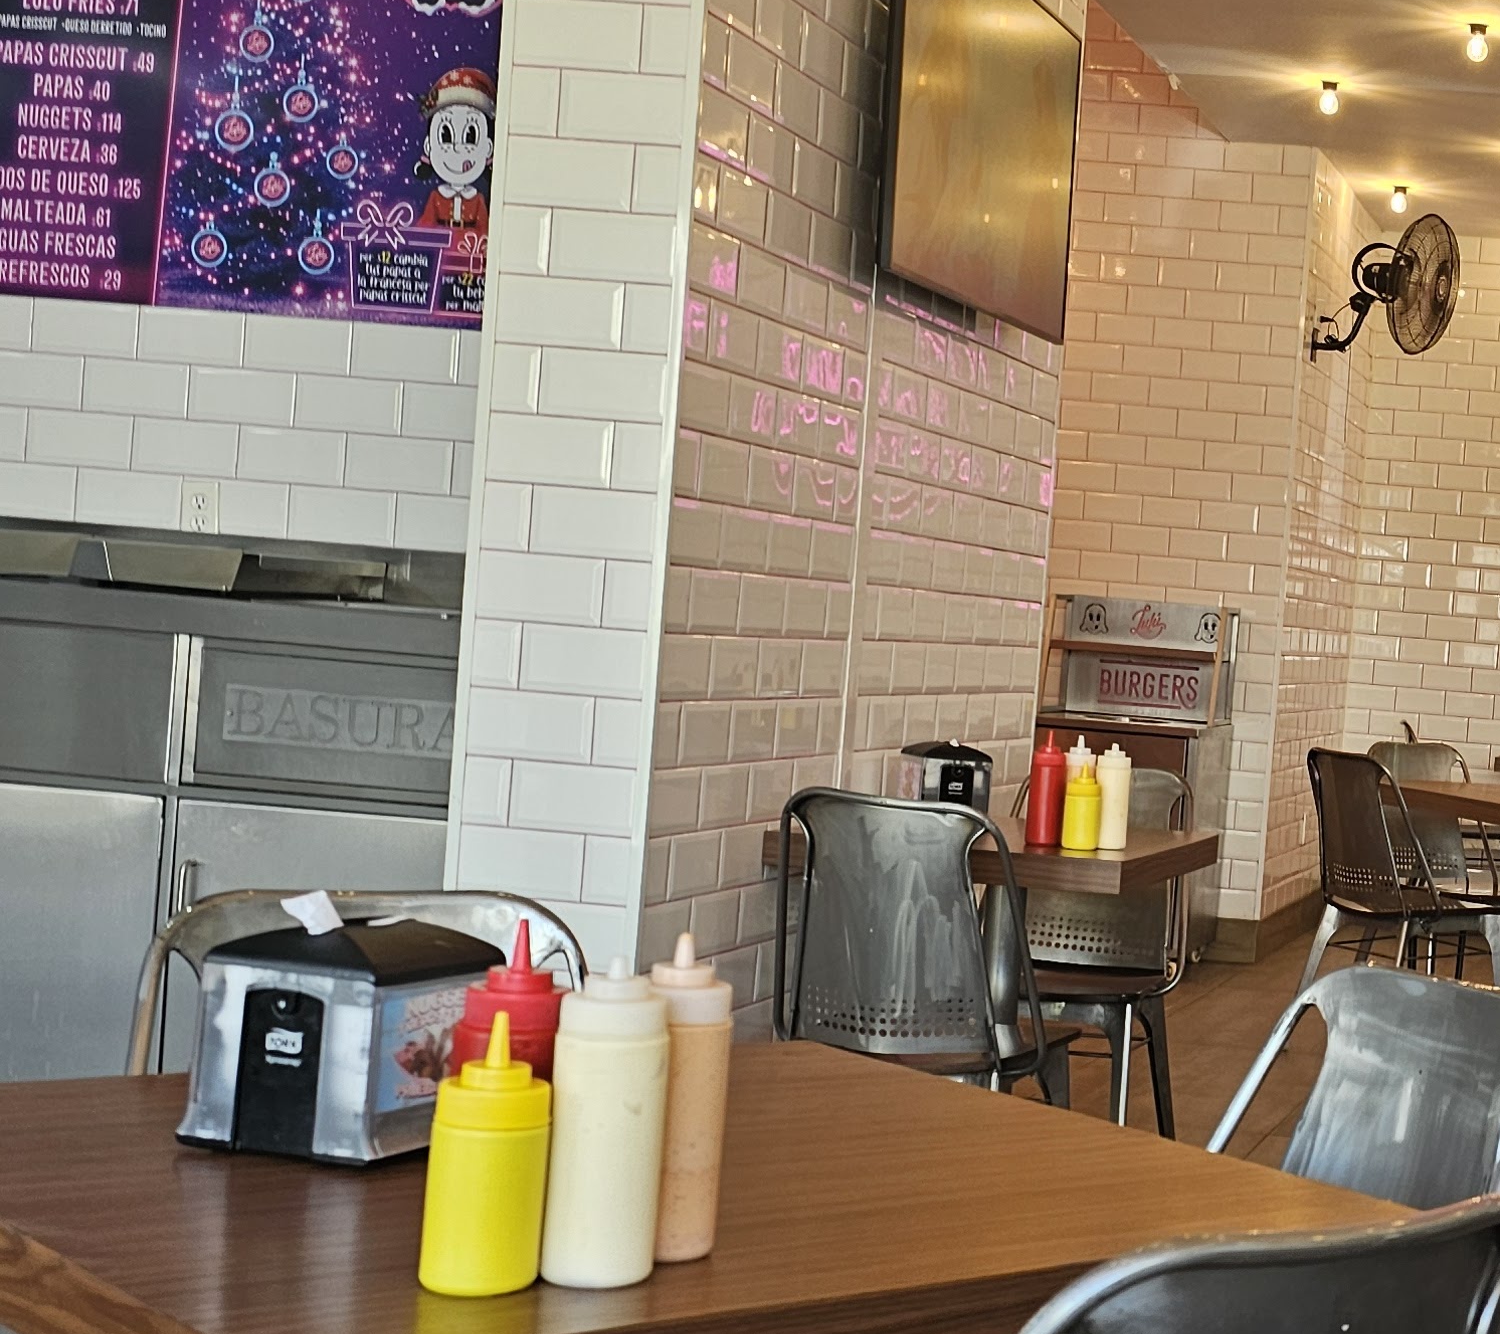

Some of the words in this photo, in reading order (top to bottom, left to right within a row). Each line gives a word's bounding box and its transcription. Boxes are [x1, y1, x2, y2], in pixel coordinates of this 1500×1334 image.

[50, 43, 129, 72] CRISSCUT
[34, 73, 84, 100] PAPAS
[18, 103, 91, 131] NUGGETS
[17, 135, 91, 163] CERVEZA
[31, 169, 51, 193] DE
[57, 171, 108, 197] QUESO
[1, 197, 86, 226] MALTEADA
[44, 231, 117, 259] FRESCAS
[1100, 669, 1198, 709] BURGERS
